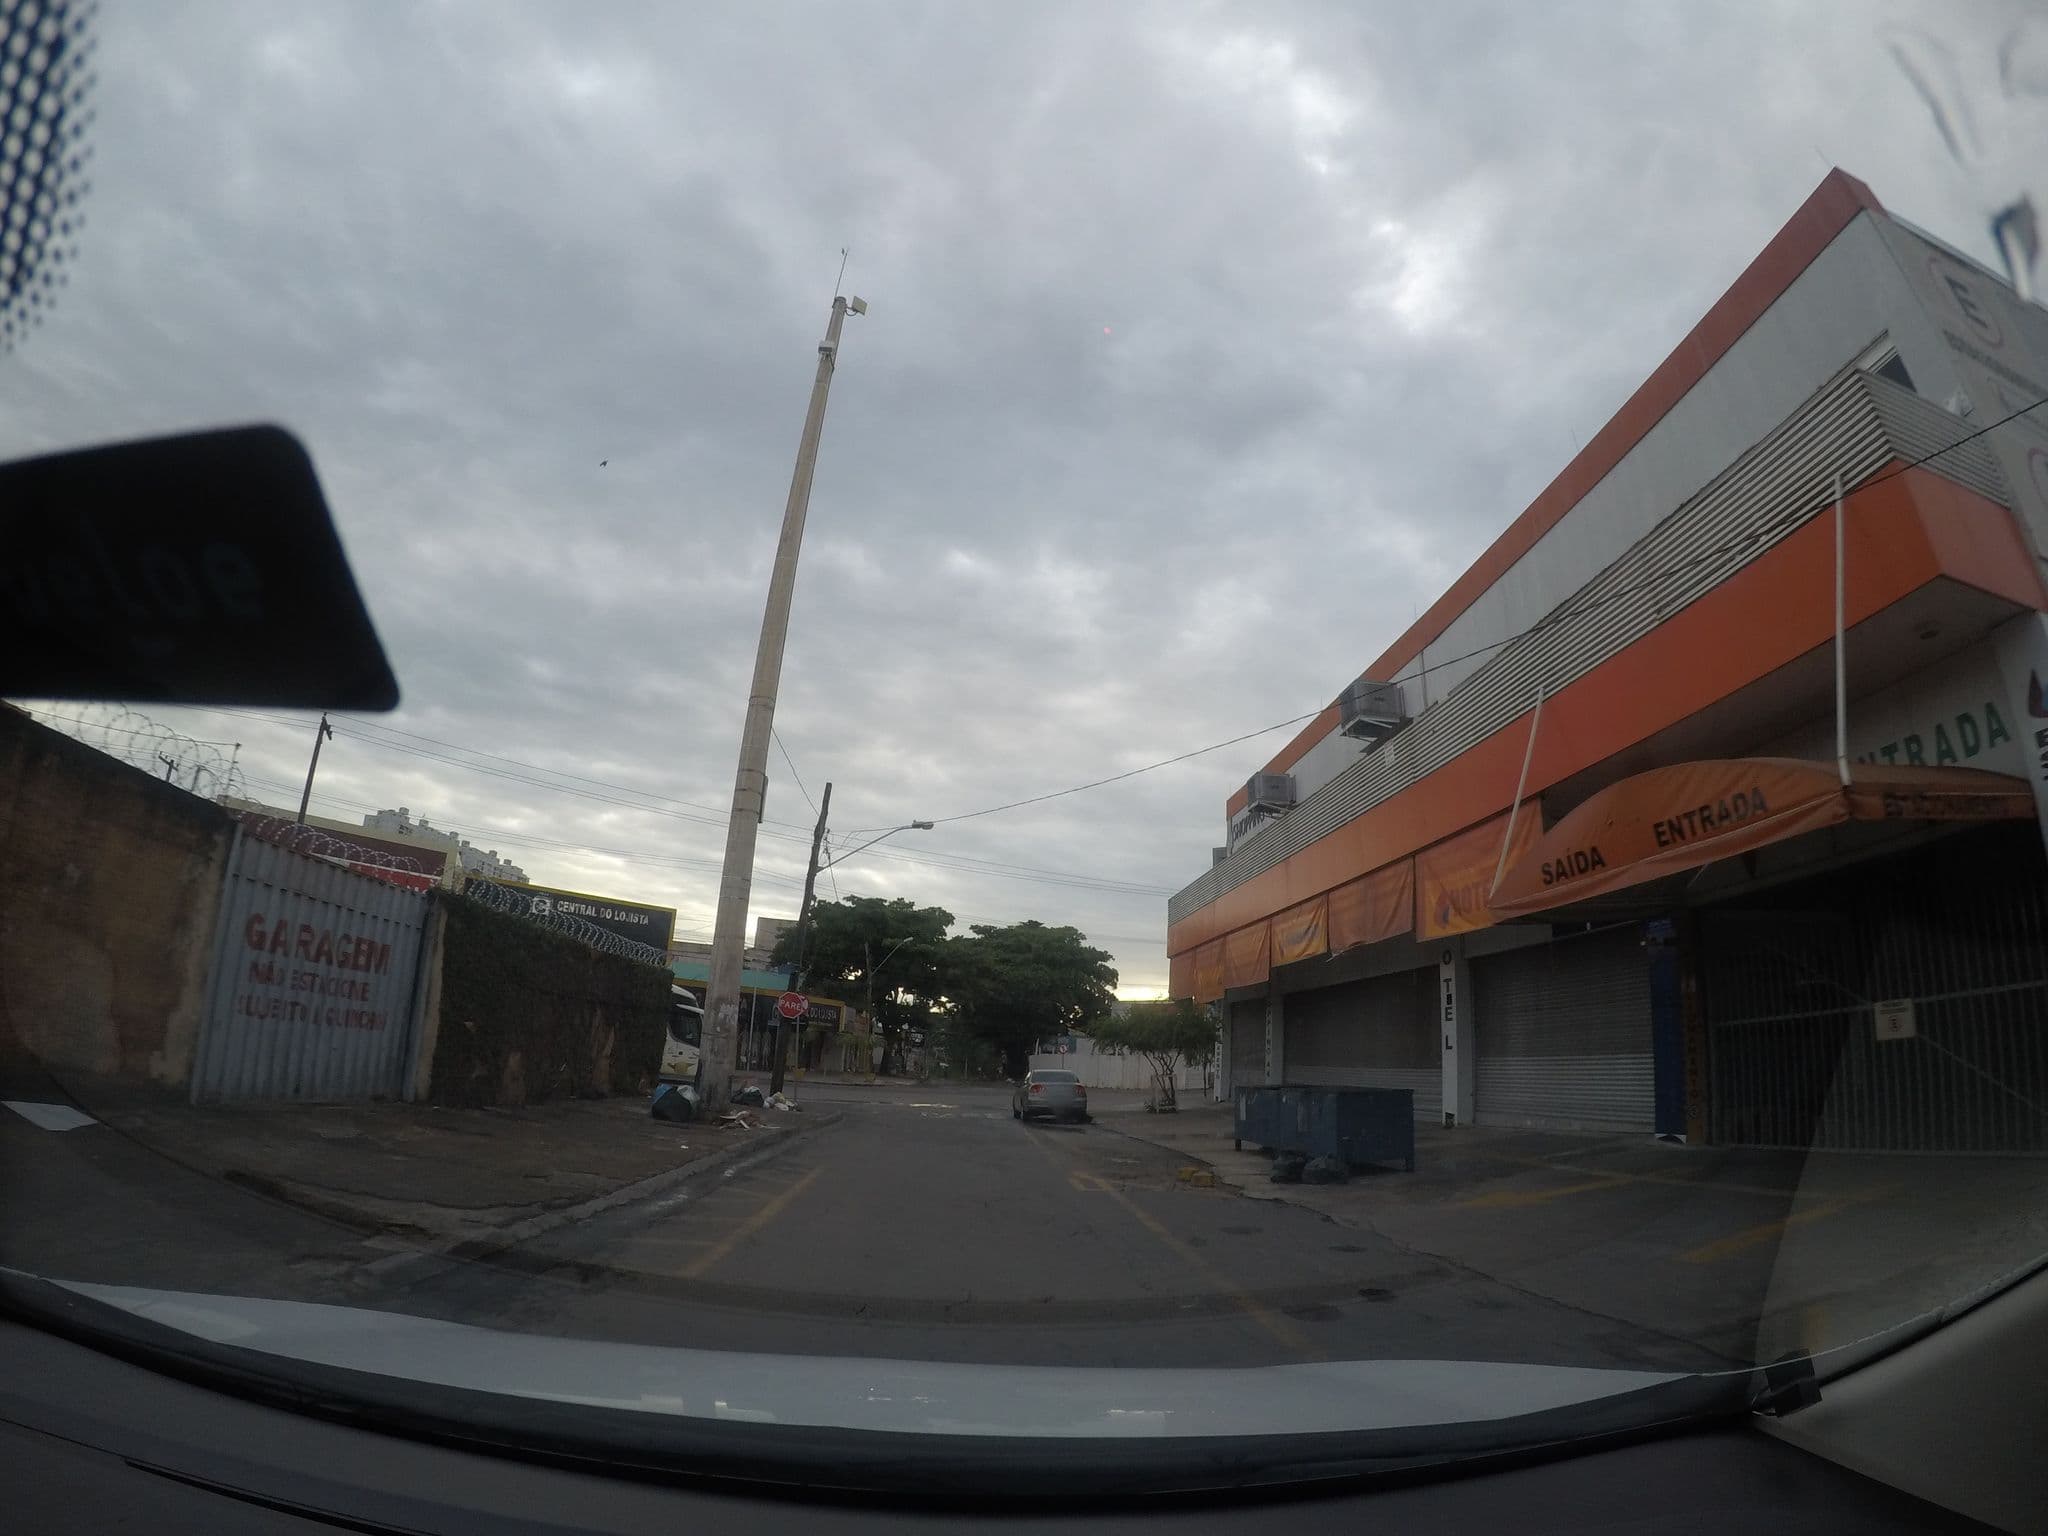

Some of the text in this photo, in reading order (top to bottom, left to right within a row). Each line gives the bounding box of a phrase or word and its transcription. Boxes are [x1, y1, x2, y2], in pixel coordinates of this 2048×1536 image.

[1652, 786, 1768, 848] ENTRADA
[1540, 845, 1607, 886] SAÍDA
[557, 900, 649, 926] CENTRAL DO LOJISTA
[245, 912, 393, 976] GARAGEM
[780, 999, 801, 1012] PARE
